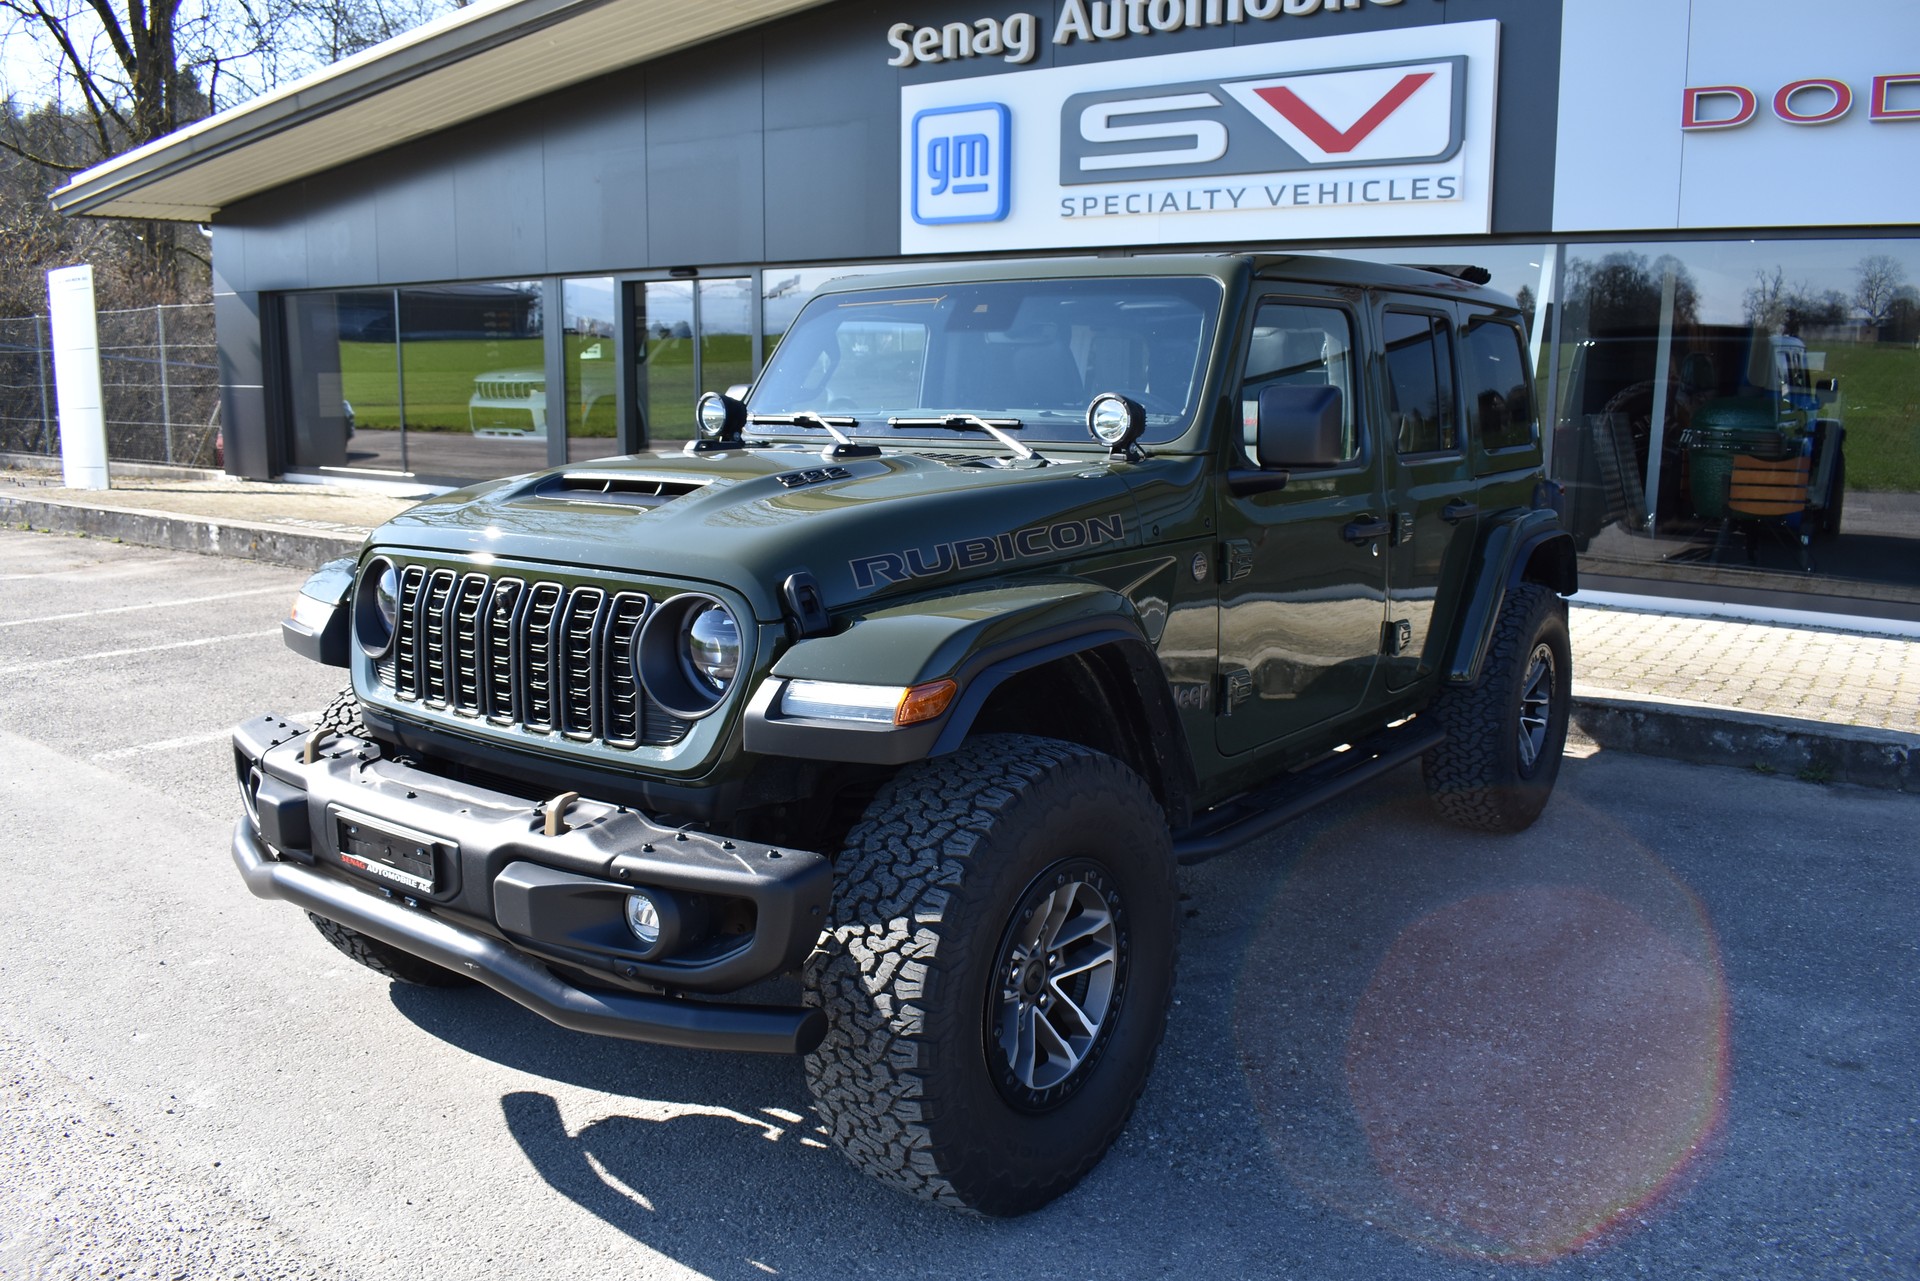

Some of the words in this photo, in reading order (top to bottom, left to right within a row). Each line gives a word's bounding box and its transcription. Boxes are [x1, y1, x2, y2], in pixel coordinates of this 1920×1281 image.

[887, 12, 1036, 67] Senag
[927, 133, 989, 196] gm
[1060, 187, 1247, 217] SPECIALTY
[1264, 176, 1456, 206] VEHICLES
[849, 513, 1125, 590] RUBICON
[366, 863, 418, 888] AUTOMOBILE
[418, 881, 431, 893] AG
